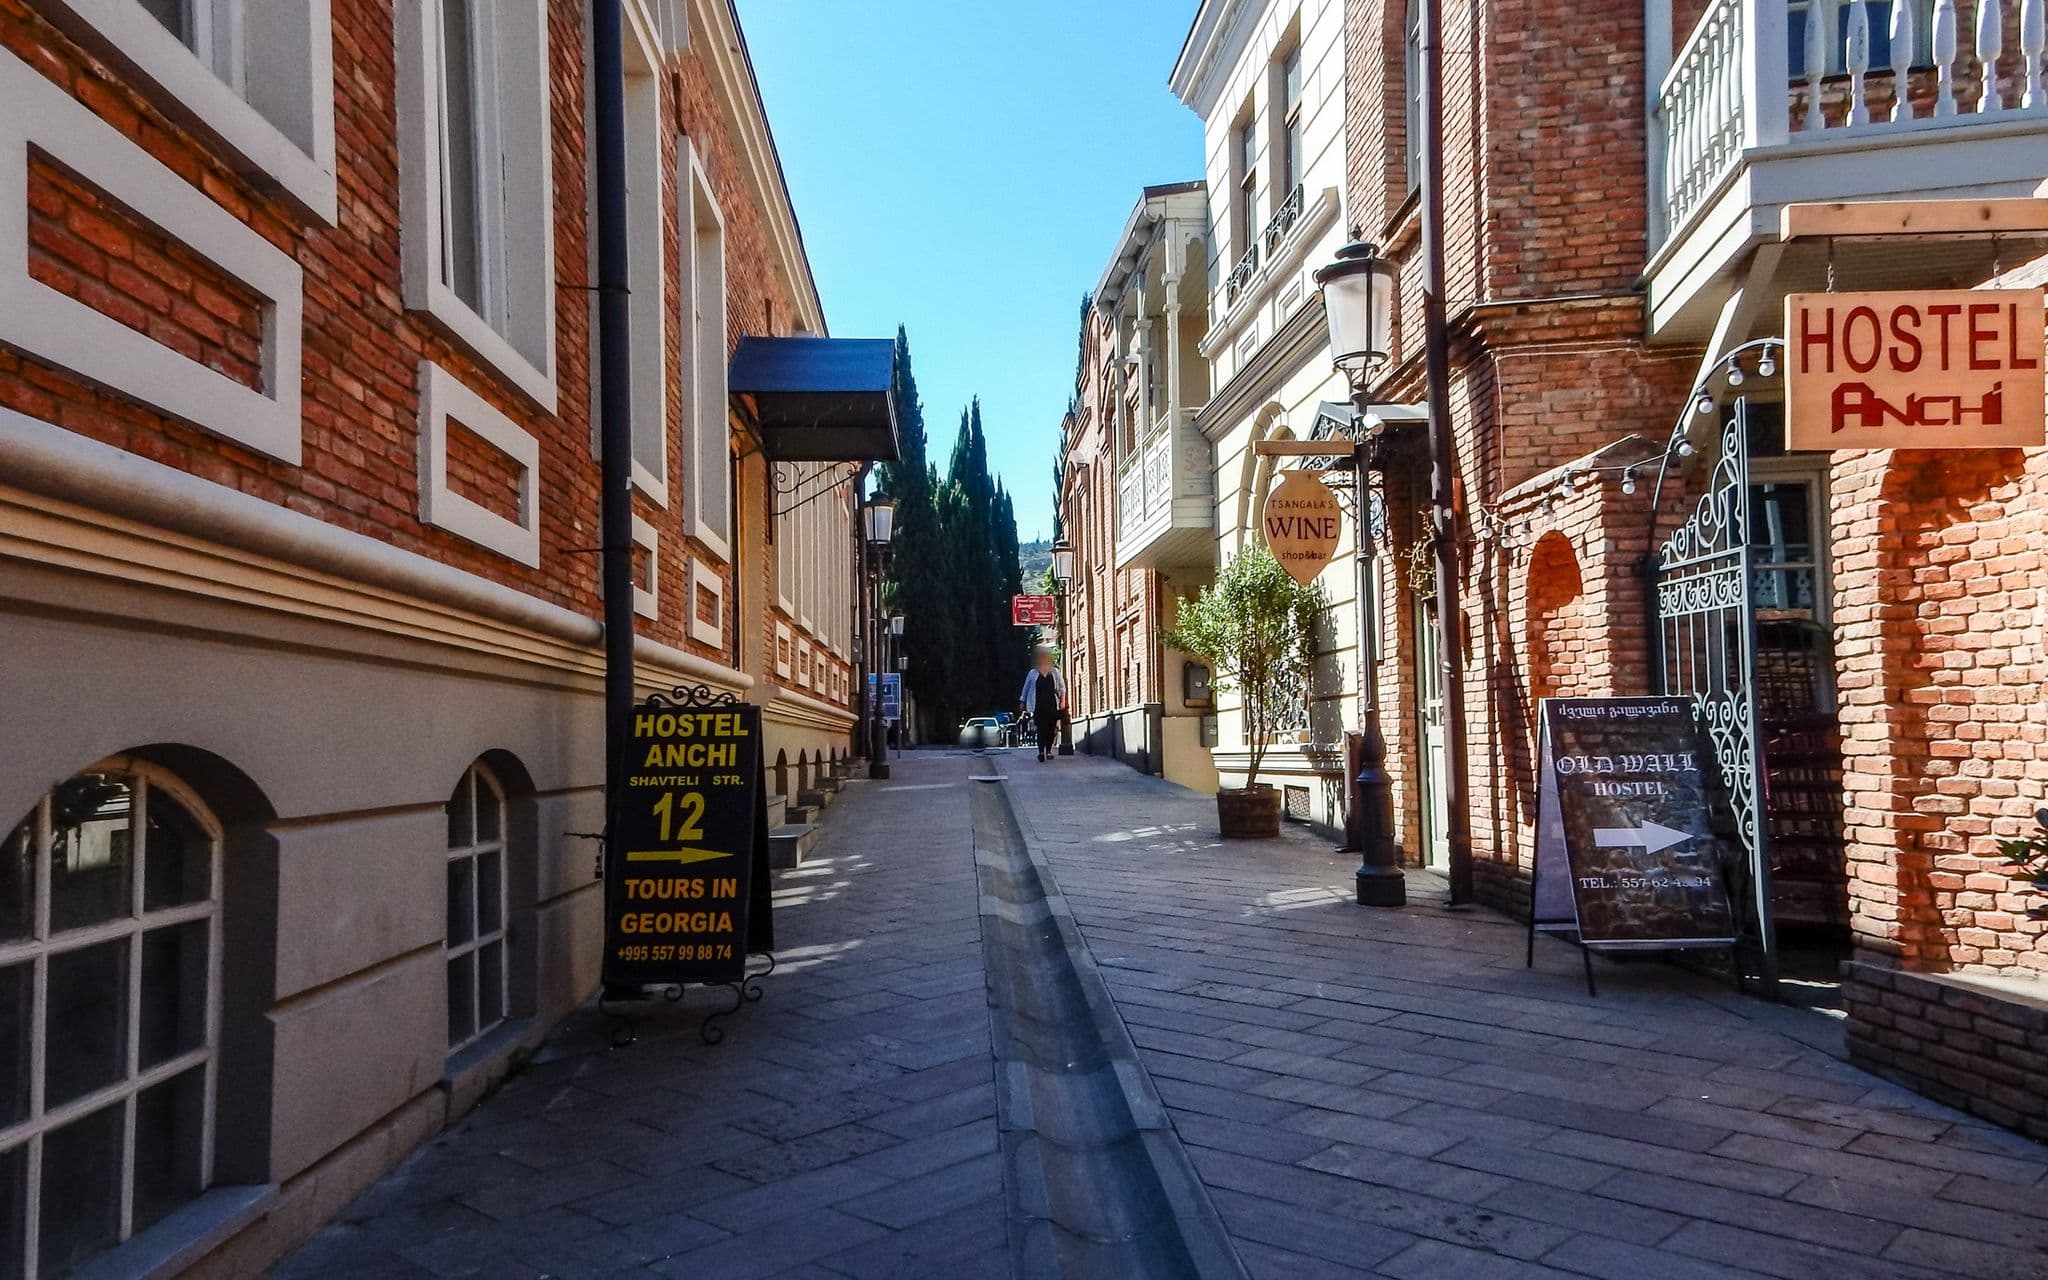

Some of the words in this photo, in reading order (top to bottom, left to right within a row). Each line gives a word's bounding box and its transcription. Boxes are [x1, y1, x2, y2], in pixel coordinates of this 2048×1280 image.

[1801, 303, 2037, 374] HOSTEL
[1271, 499, 1334, 509] TSANGALA'S
[1267, 516, 1337, 540] WINE
[634, 713, 749, 738] HOSTEL
[644, 743, 737, 768] ANCHI
[1556, 754, 1614, 775] OLD
[1621, 753, 1698, 773] WALL
[629, 775, 699, 787] SHAVTELI
[712, 775, 744, 785] STR.
[1593, 781, 1669, 796] HOSTEL
[652, 792, 705, 841] 12
[624, 878, 705, 900] TOURS
[712, 878, 737, 898] IN
[620, 912, 733, 934] GEORGIA
[618, 945, 648, 961] +995
[651, 945, 674, 961] 557
[678, 945, 694, 960] 99
[697, 945, 713, 960] 88
[717, 944, 732, 960] 74
